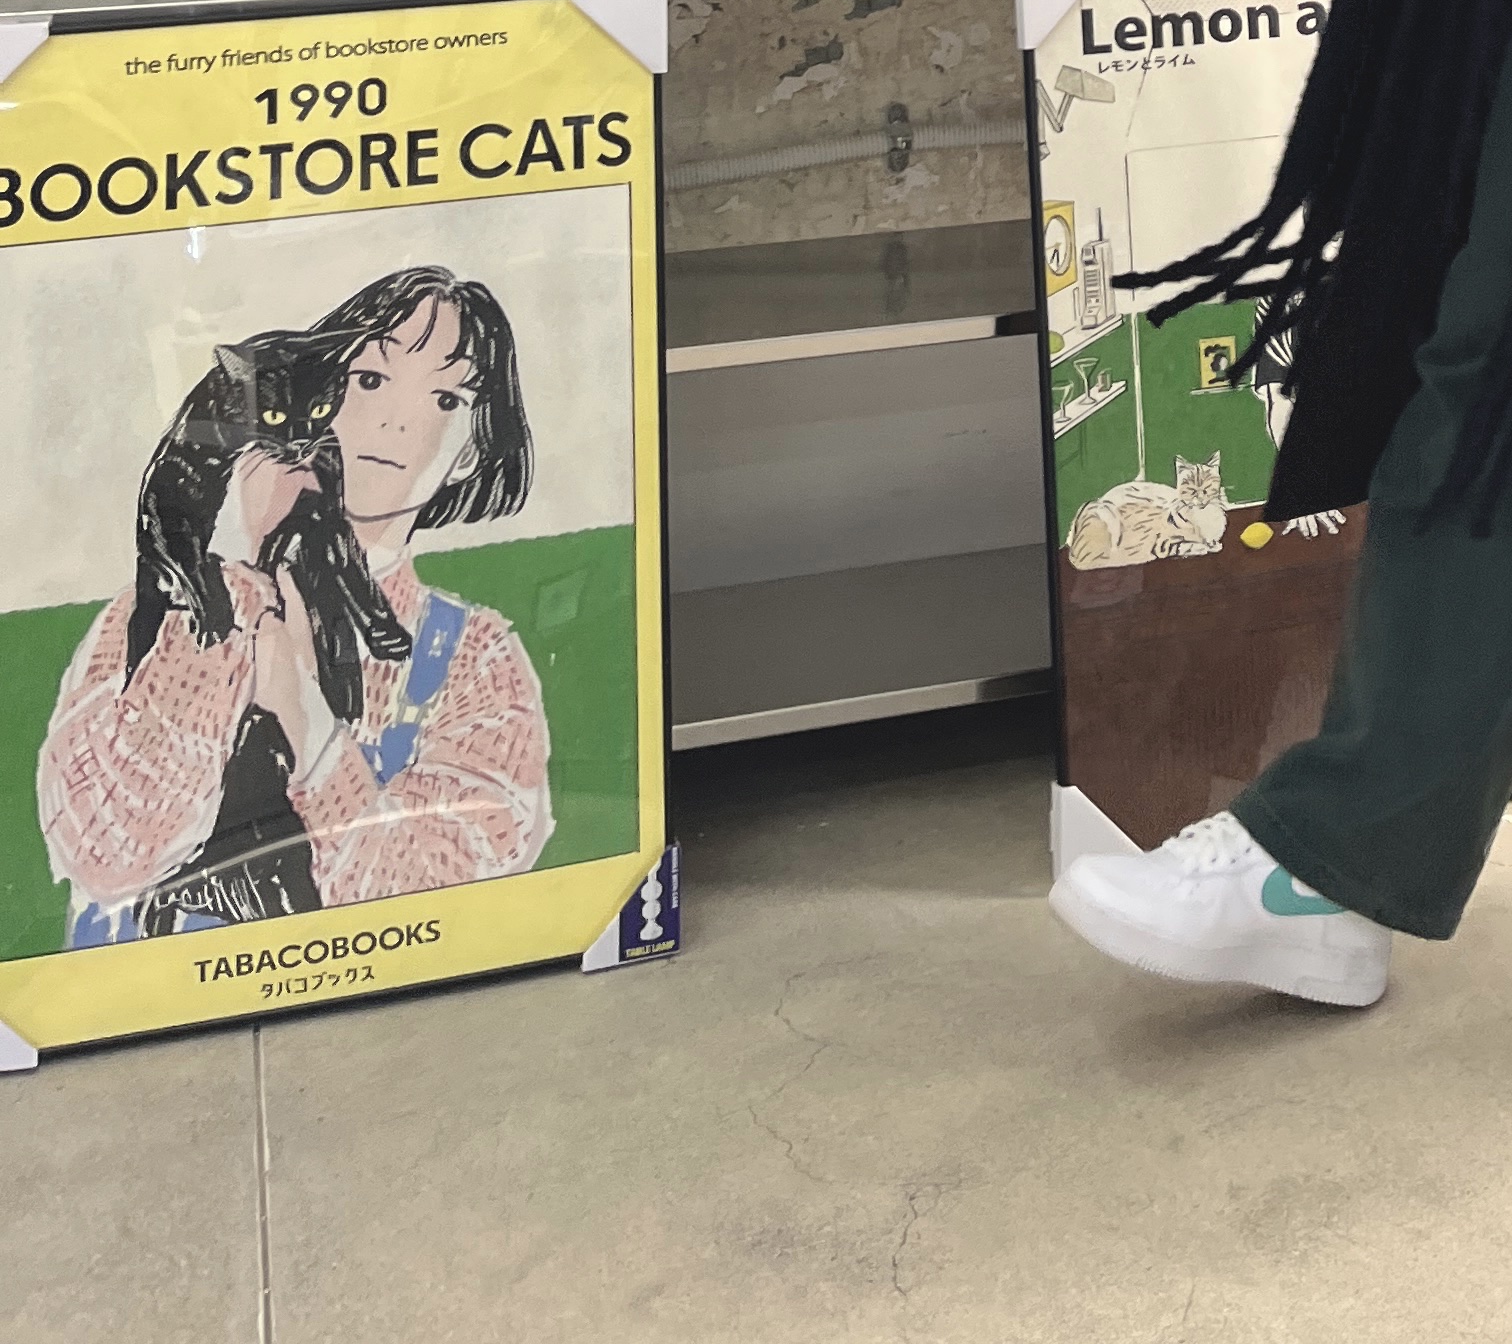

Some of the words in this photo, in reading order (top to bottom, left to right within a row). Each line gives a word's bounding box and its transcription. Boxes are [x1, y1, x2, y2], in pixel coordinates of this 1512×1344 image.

[125, 56, 162, 76] the
[166, 49, 218, 73] furry
[221, 45, 293, 68] friends
[299, 41, 322, 62] of
[325, 35, 429, 58] bookstore
[434, 30, 509, 51] owners
[1081, 2, 1281, 55] Lemon
[1098, 53, 1197, 74] レモンとライム
[254, 76, 388, 125] 1990
[459, 111, 632, 180] CATS
[194, 919, 442, 984] TABACOBOOKS
[260, 965, 376, 1000] タバコブックス
